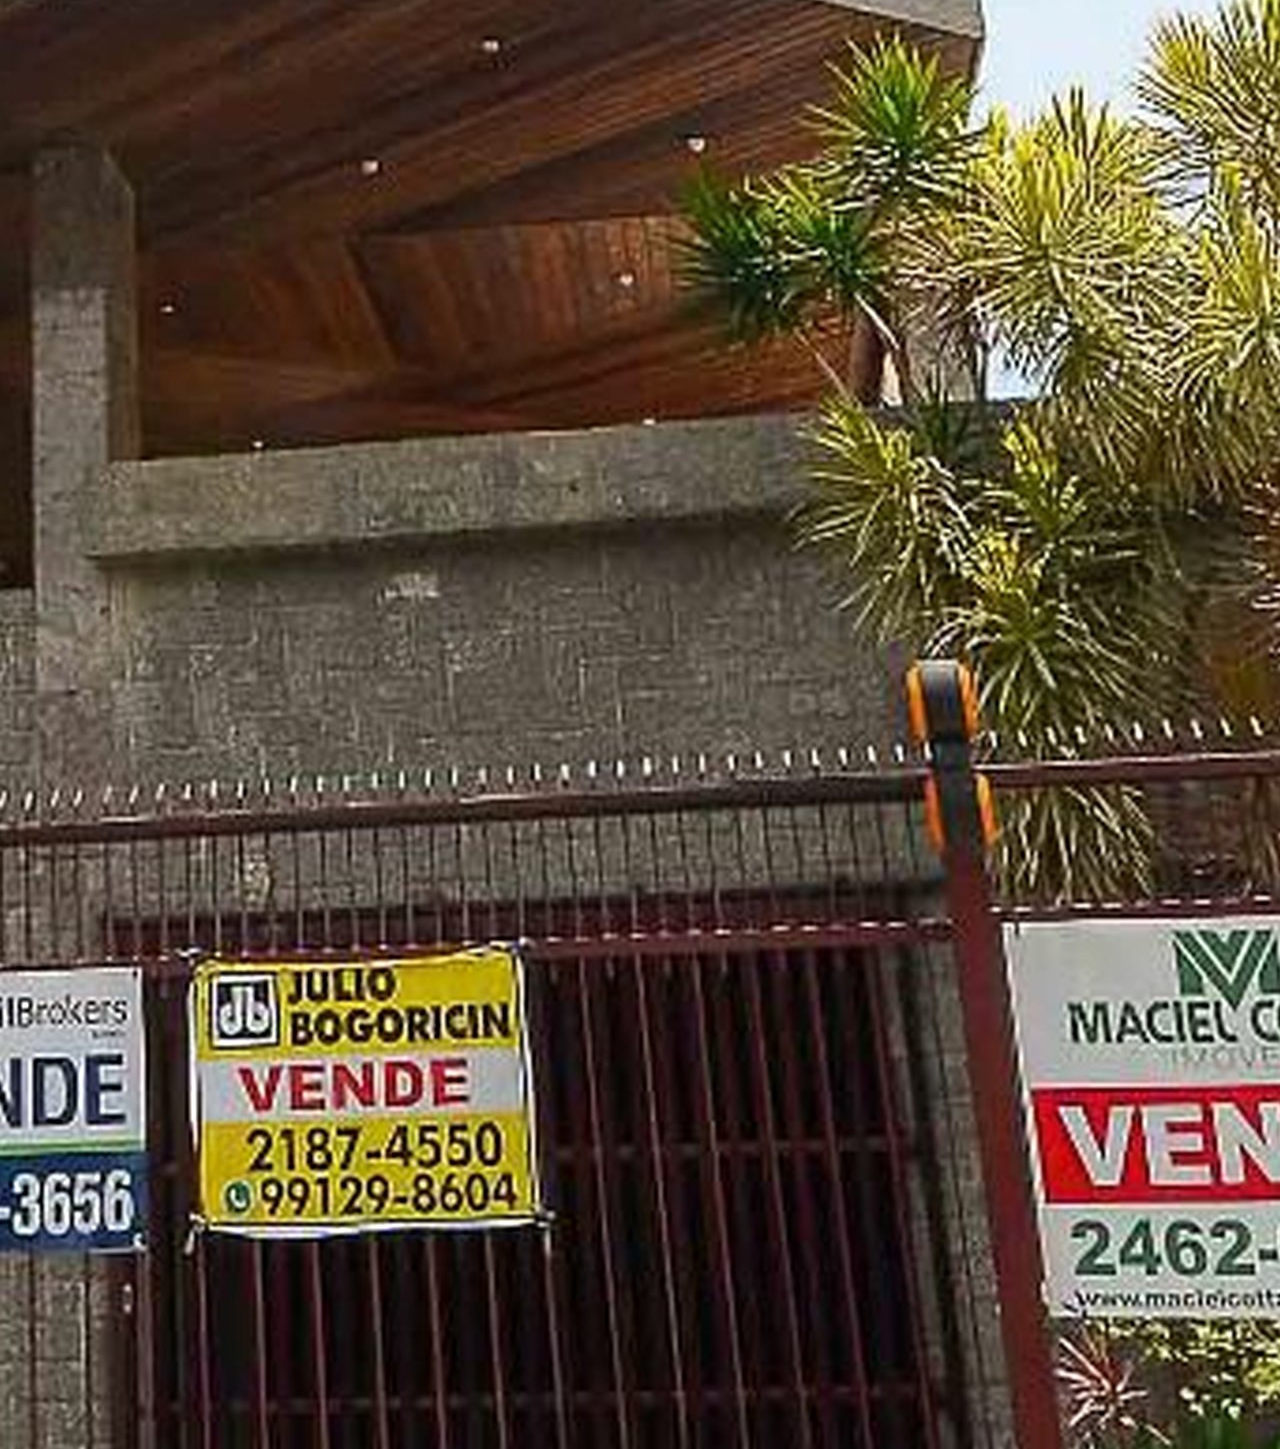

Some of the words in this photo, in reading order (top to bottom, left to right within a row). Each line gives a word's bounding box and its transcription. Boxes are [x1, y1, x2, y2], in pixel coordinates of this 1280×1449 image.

[287, 966, 397, 1003] JULIO
[290, 1002, 511, 1046] BOGORICIN
[1068, 1000, 1239, 1044] MACIEL
[238, 1058, 470, 1113] VENDE
[247, 1122, 503, 1171] 2187-4550
[260, 1172, 518, 1216] 99129-8604
